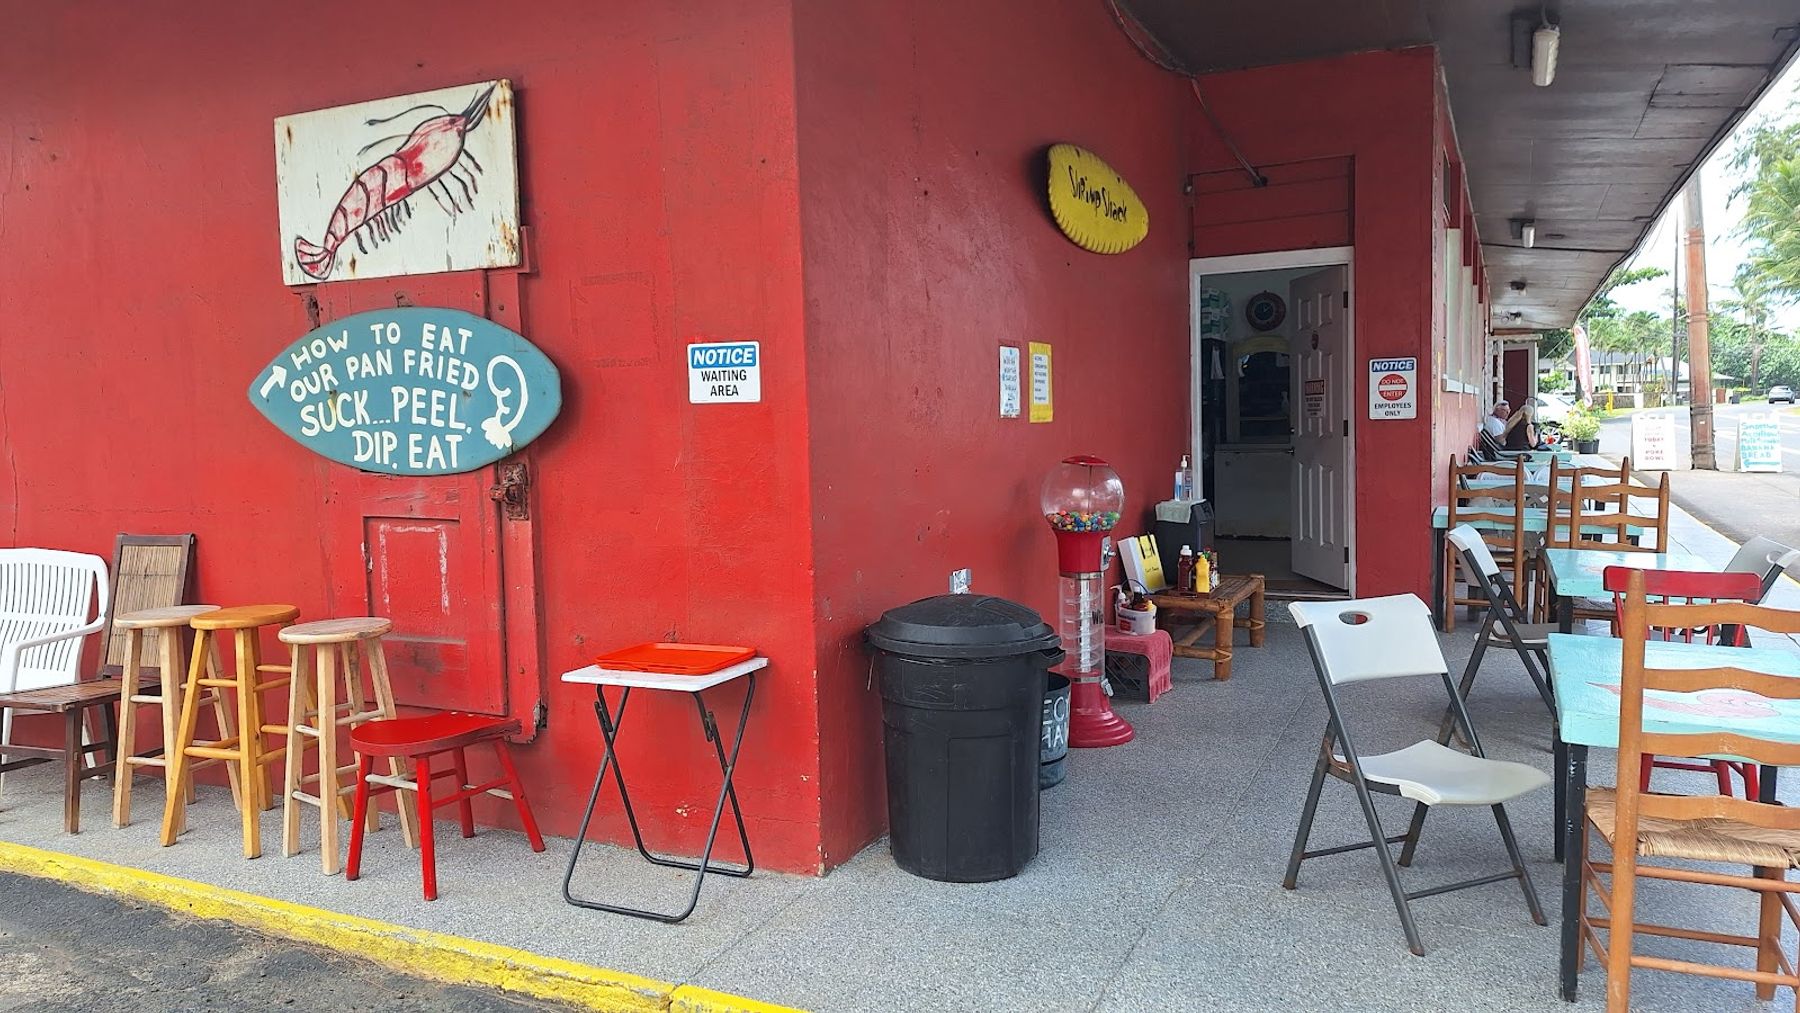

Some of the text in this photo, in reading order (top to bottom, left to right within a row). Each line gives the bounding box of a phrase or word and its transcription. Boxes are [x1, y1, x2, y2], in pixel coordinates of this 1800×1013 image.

[290, 322, 473, 371] HOW TO EAT
[693, 348, 754, 365] NOTICE
[1373, 361, 1413, 370] NOTICE
[290, 349, 480, 402] OUR PAN FRIED
[701, 369, 747, 382] WAITING
[710, 384, 739, 397] AREA
[1383, 390, 1403, 398] ENTER
[408, 434, 463, 470] EAT
